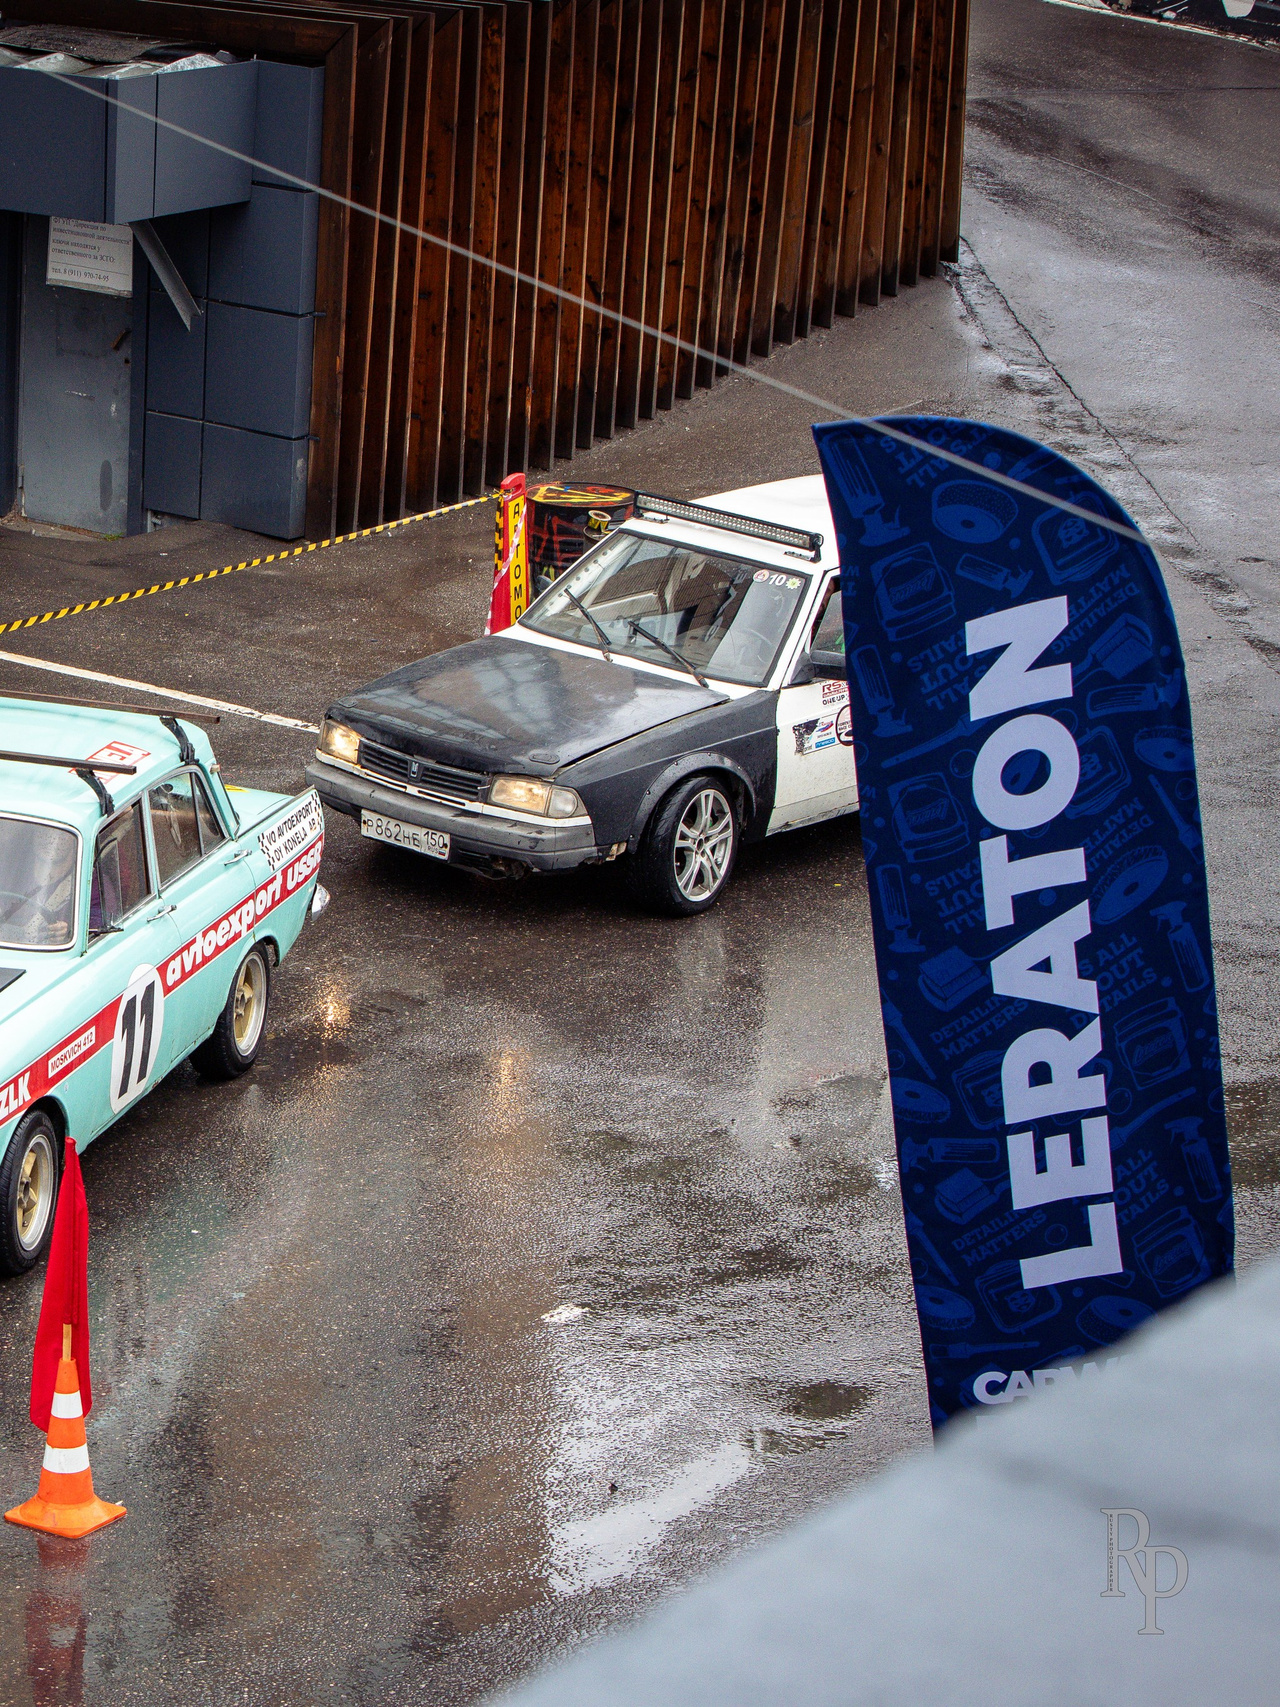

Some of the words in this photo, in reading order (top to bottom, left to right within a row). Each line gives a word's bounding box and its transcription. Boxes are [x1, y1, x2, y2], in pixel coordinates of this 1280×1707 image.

[68, 268, 82, 278] (911)
[769, 574, 787, 586] 10
[1051, 582, 1140, 655] DETAILING
[266, 830, 276, 846] VO
[277, 801, 313, 839] AVTOEXPORT
[273, 846, 284, 862] OY
[282, 826, 308, 855] KONELA
[423, 830, 445, 848] 150
[166, 869, 283, 987] avtoexport
[287, 840, 322, 891] USSR
[965, 595, 1123, 1289] LERATON
[50, 1040, 82, 1073] MOSKVICH
[83, 1031, 94, 1047] 412
[118, 980, 155, 1100] 11
[939, 1000, 1029, 1061] MATTERS
[961, 1209, 1047, 1267] MATTERS
